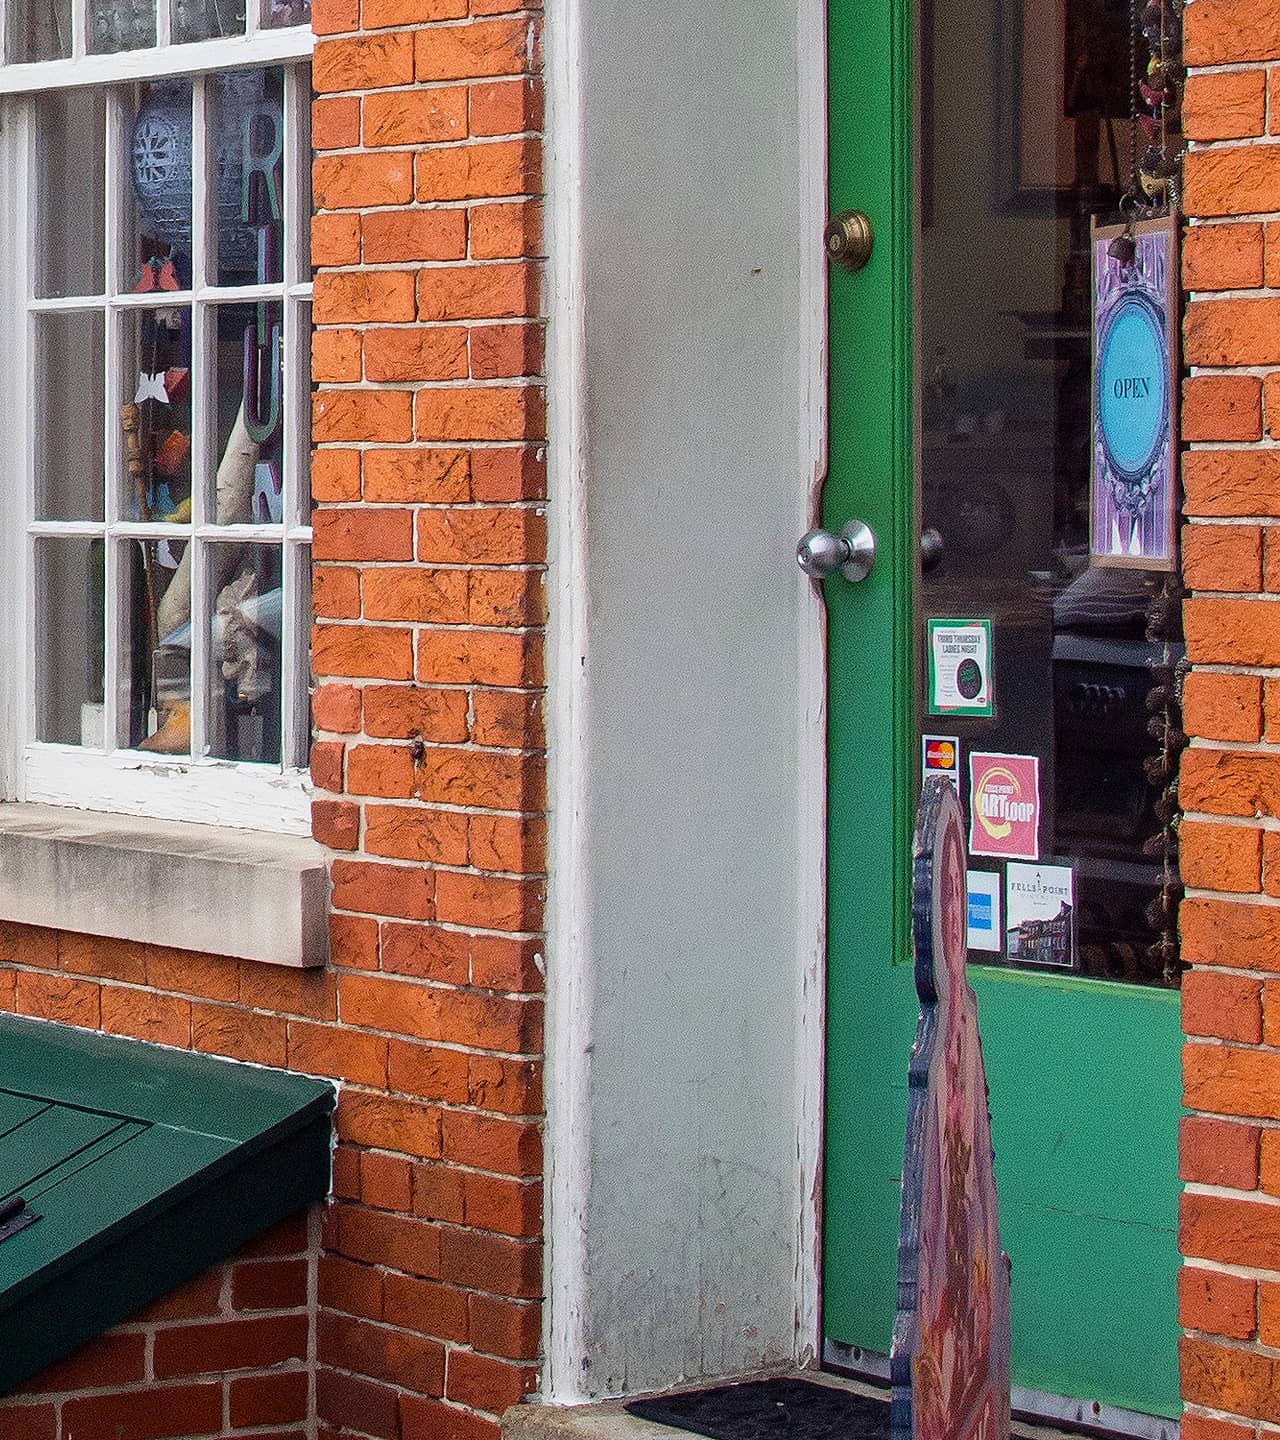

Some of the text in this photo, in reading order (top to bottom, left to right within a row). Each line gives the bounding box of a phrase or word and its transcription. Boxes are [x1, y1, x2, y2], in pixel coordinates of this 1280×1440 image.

[1113, 378, 1150, 400] OPEN
[981, 793, 1035, 823] ART LOOP
[1043, 885, 1068, 896] POINT
